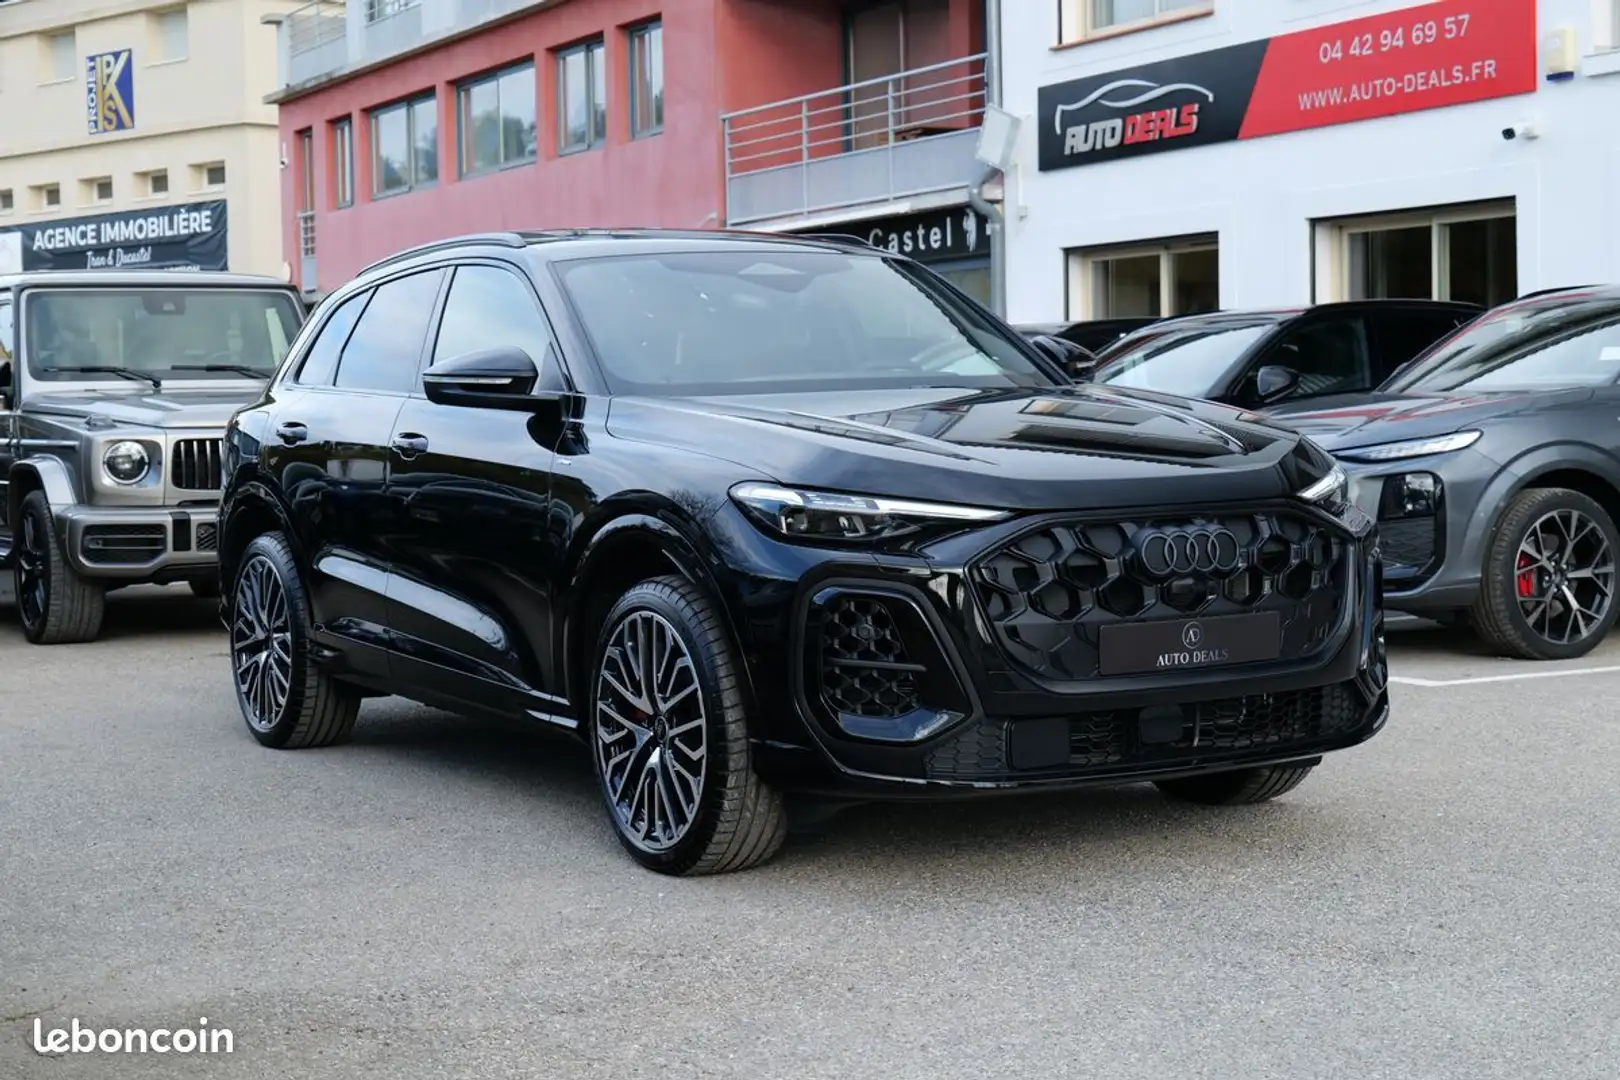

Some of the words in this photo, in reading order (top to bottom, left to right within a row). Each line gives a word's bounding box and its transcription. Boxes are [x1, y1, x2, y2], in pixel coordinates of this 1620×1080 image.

[1318, 40, 1343, 65] 04
[1348, 35, 1374, 60] 42
[1378, 29, 1405, 54] 94
[1411, 21, 1438, 46] 69
[1444, 13, 1471, 39] 57
[87, 57, 97, 133] PROJET
[1297, 58, 1497, 112] WWW.AUTO-DEALS.FR
[33, 224, 97, 251] AGENCE
[100, 209, 212, 242] IMMOBILIÈRE
[868, 216, 952, 254] Castel
[1156, 651, 1189, 667] AUTO
[1193, 648, 1229, 663] DEALS
